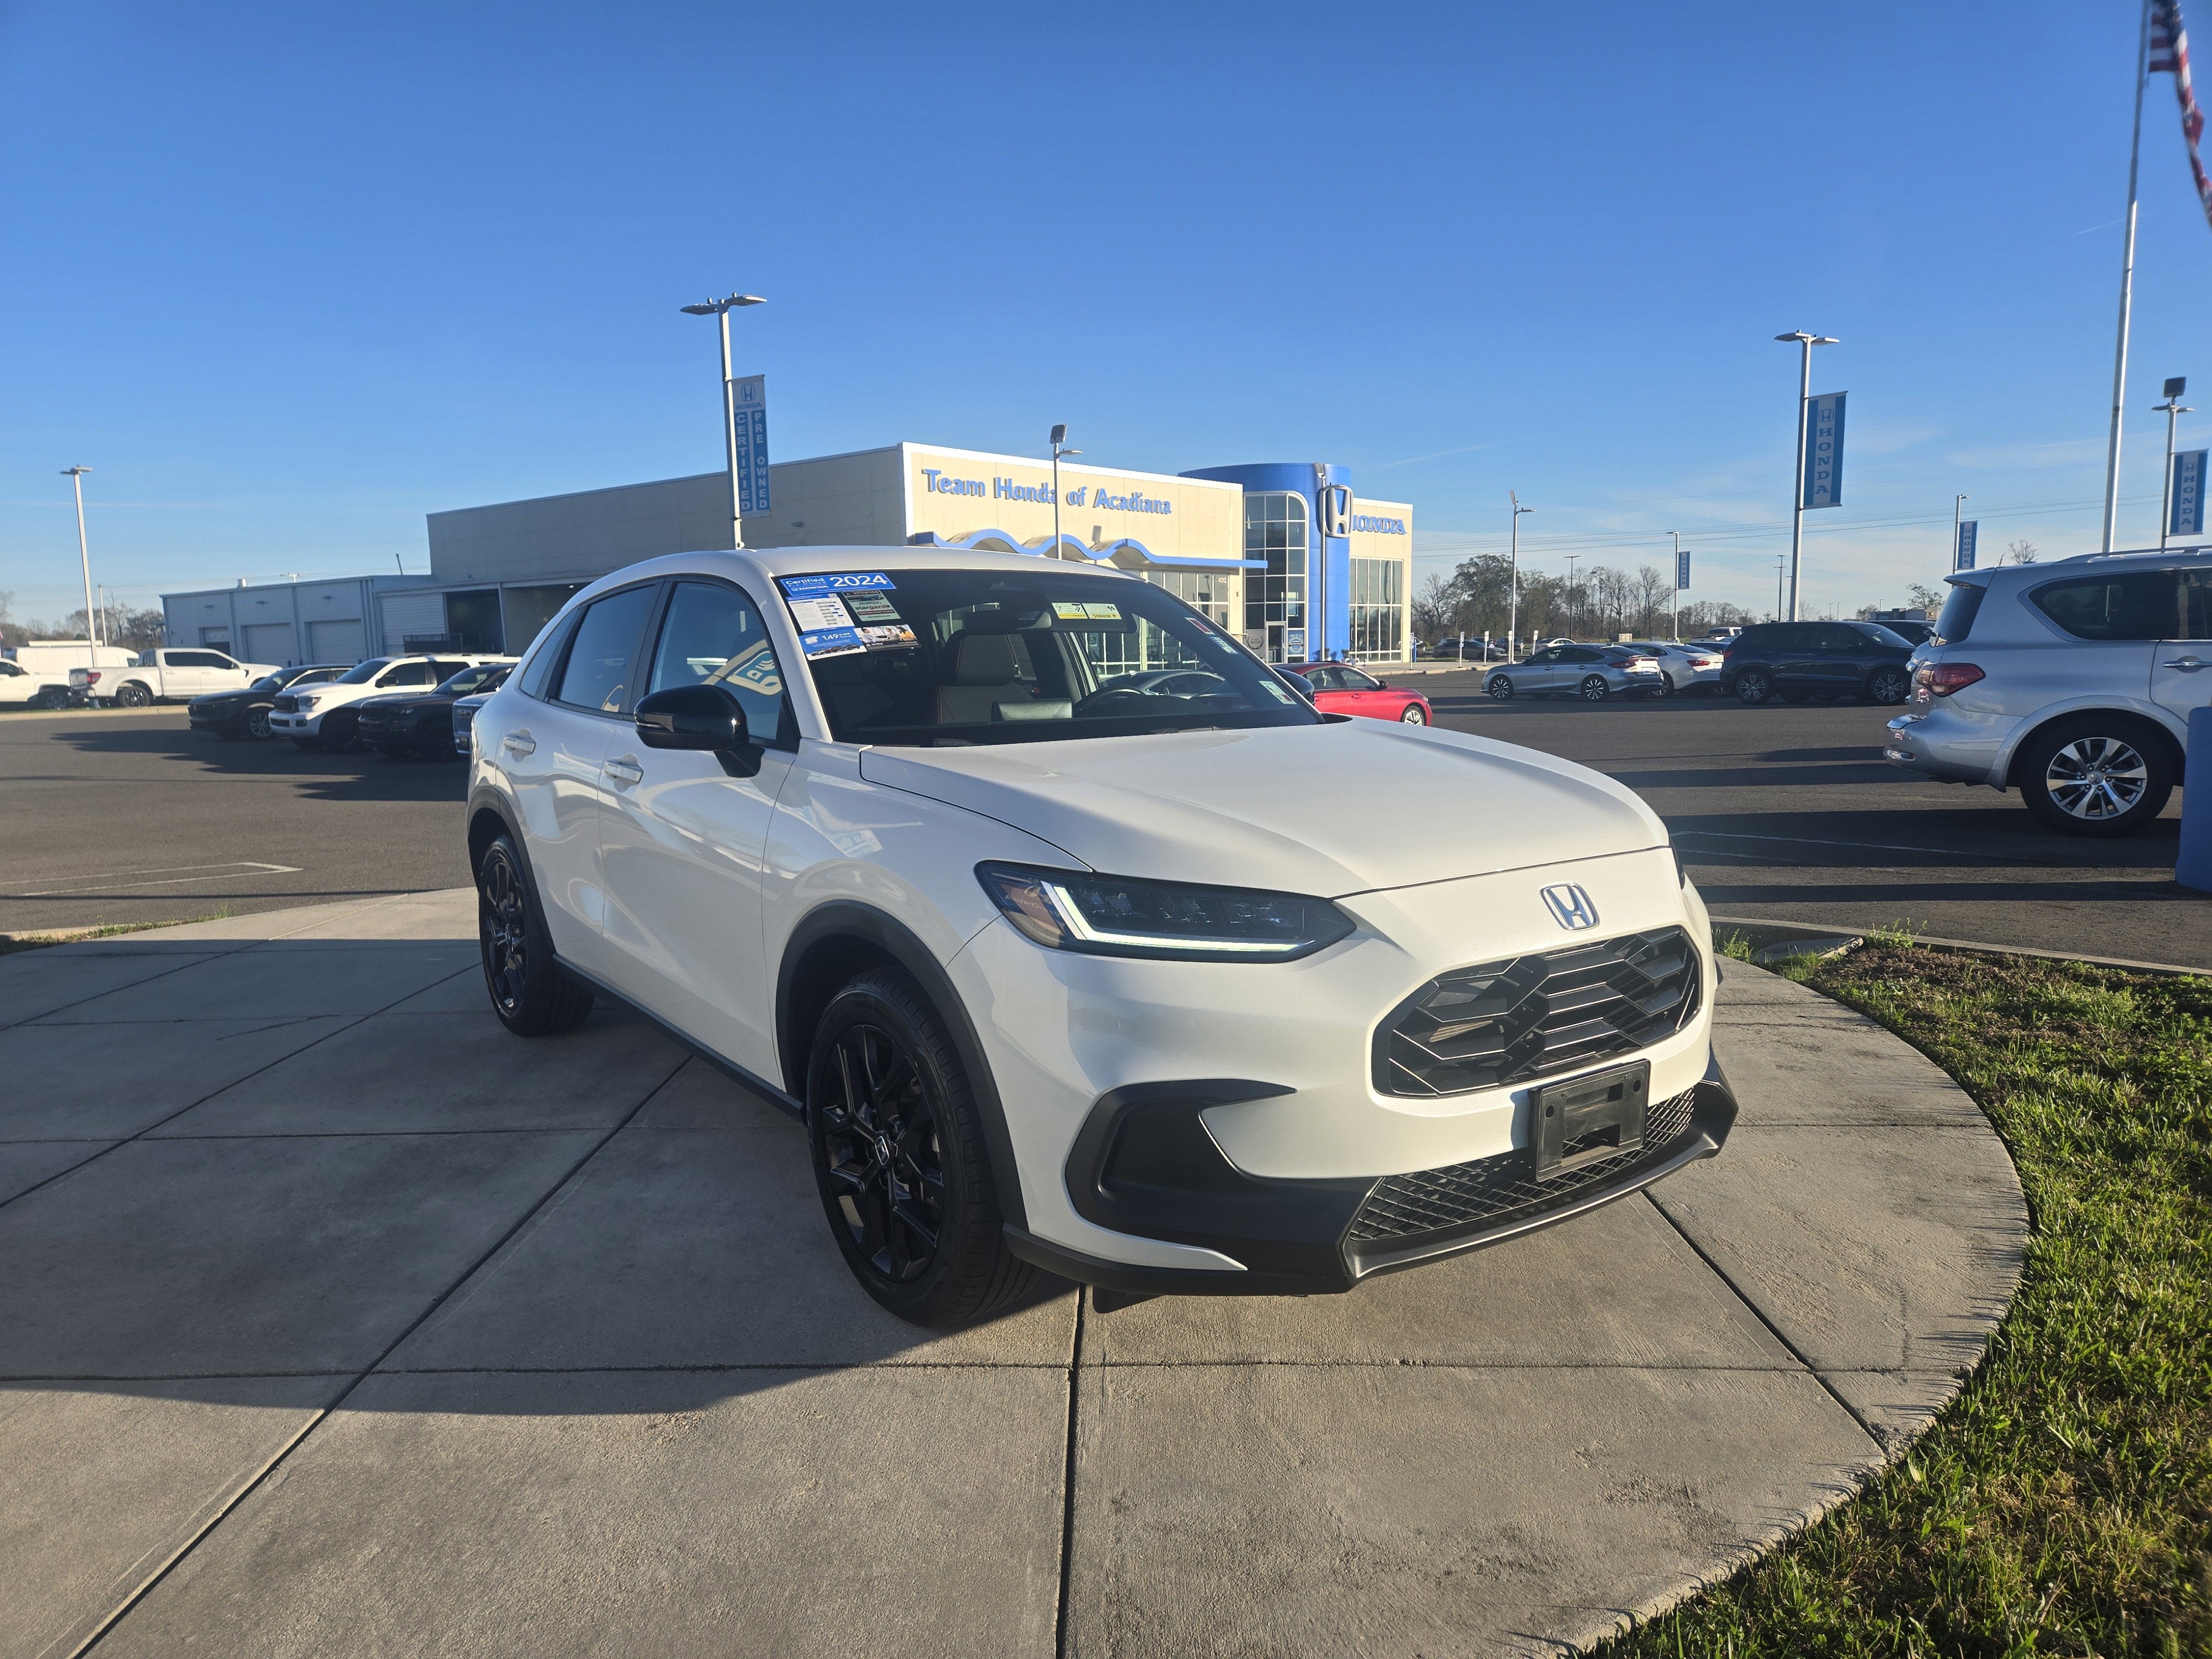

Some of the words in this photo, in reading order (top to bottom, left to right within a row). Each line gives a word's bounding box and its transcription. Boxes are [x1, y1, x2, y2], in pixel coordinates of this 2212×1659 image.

[754, 413, 764, 444] PRE
[736, 414, 750, 512] CERTIFIED
[756, 457, 768, 509] OWNED
[1815, 427, 1833, 494] HONDA
[922, 468, 985, 497] Team
[993, 477, 1056, 504] Honda
[1066, 486, 1087, 507] of
[1093, 488, 1172, 514] Acadiana
[2180, 476, 2195, 525] HONDA
[830, 575, 888, 587] 2024
